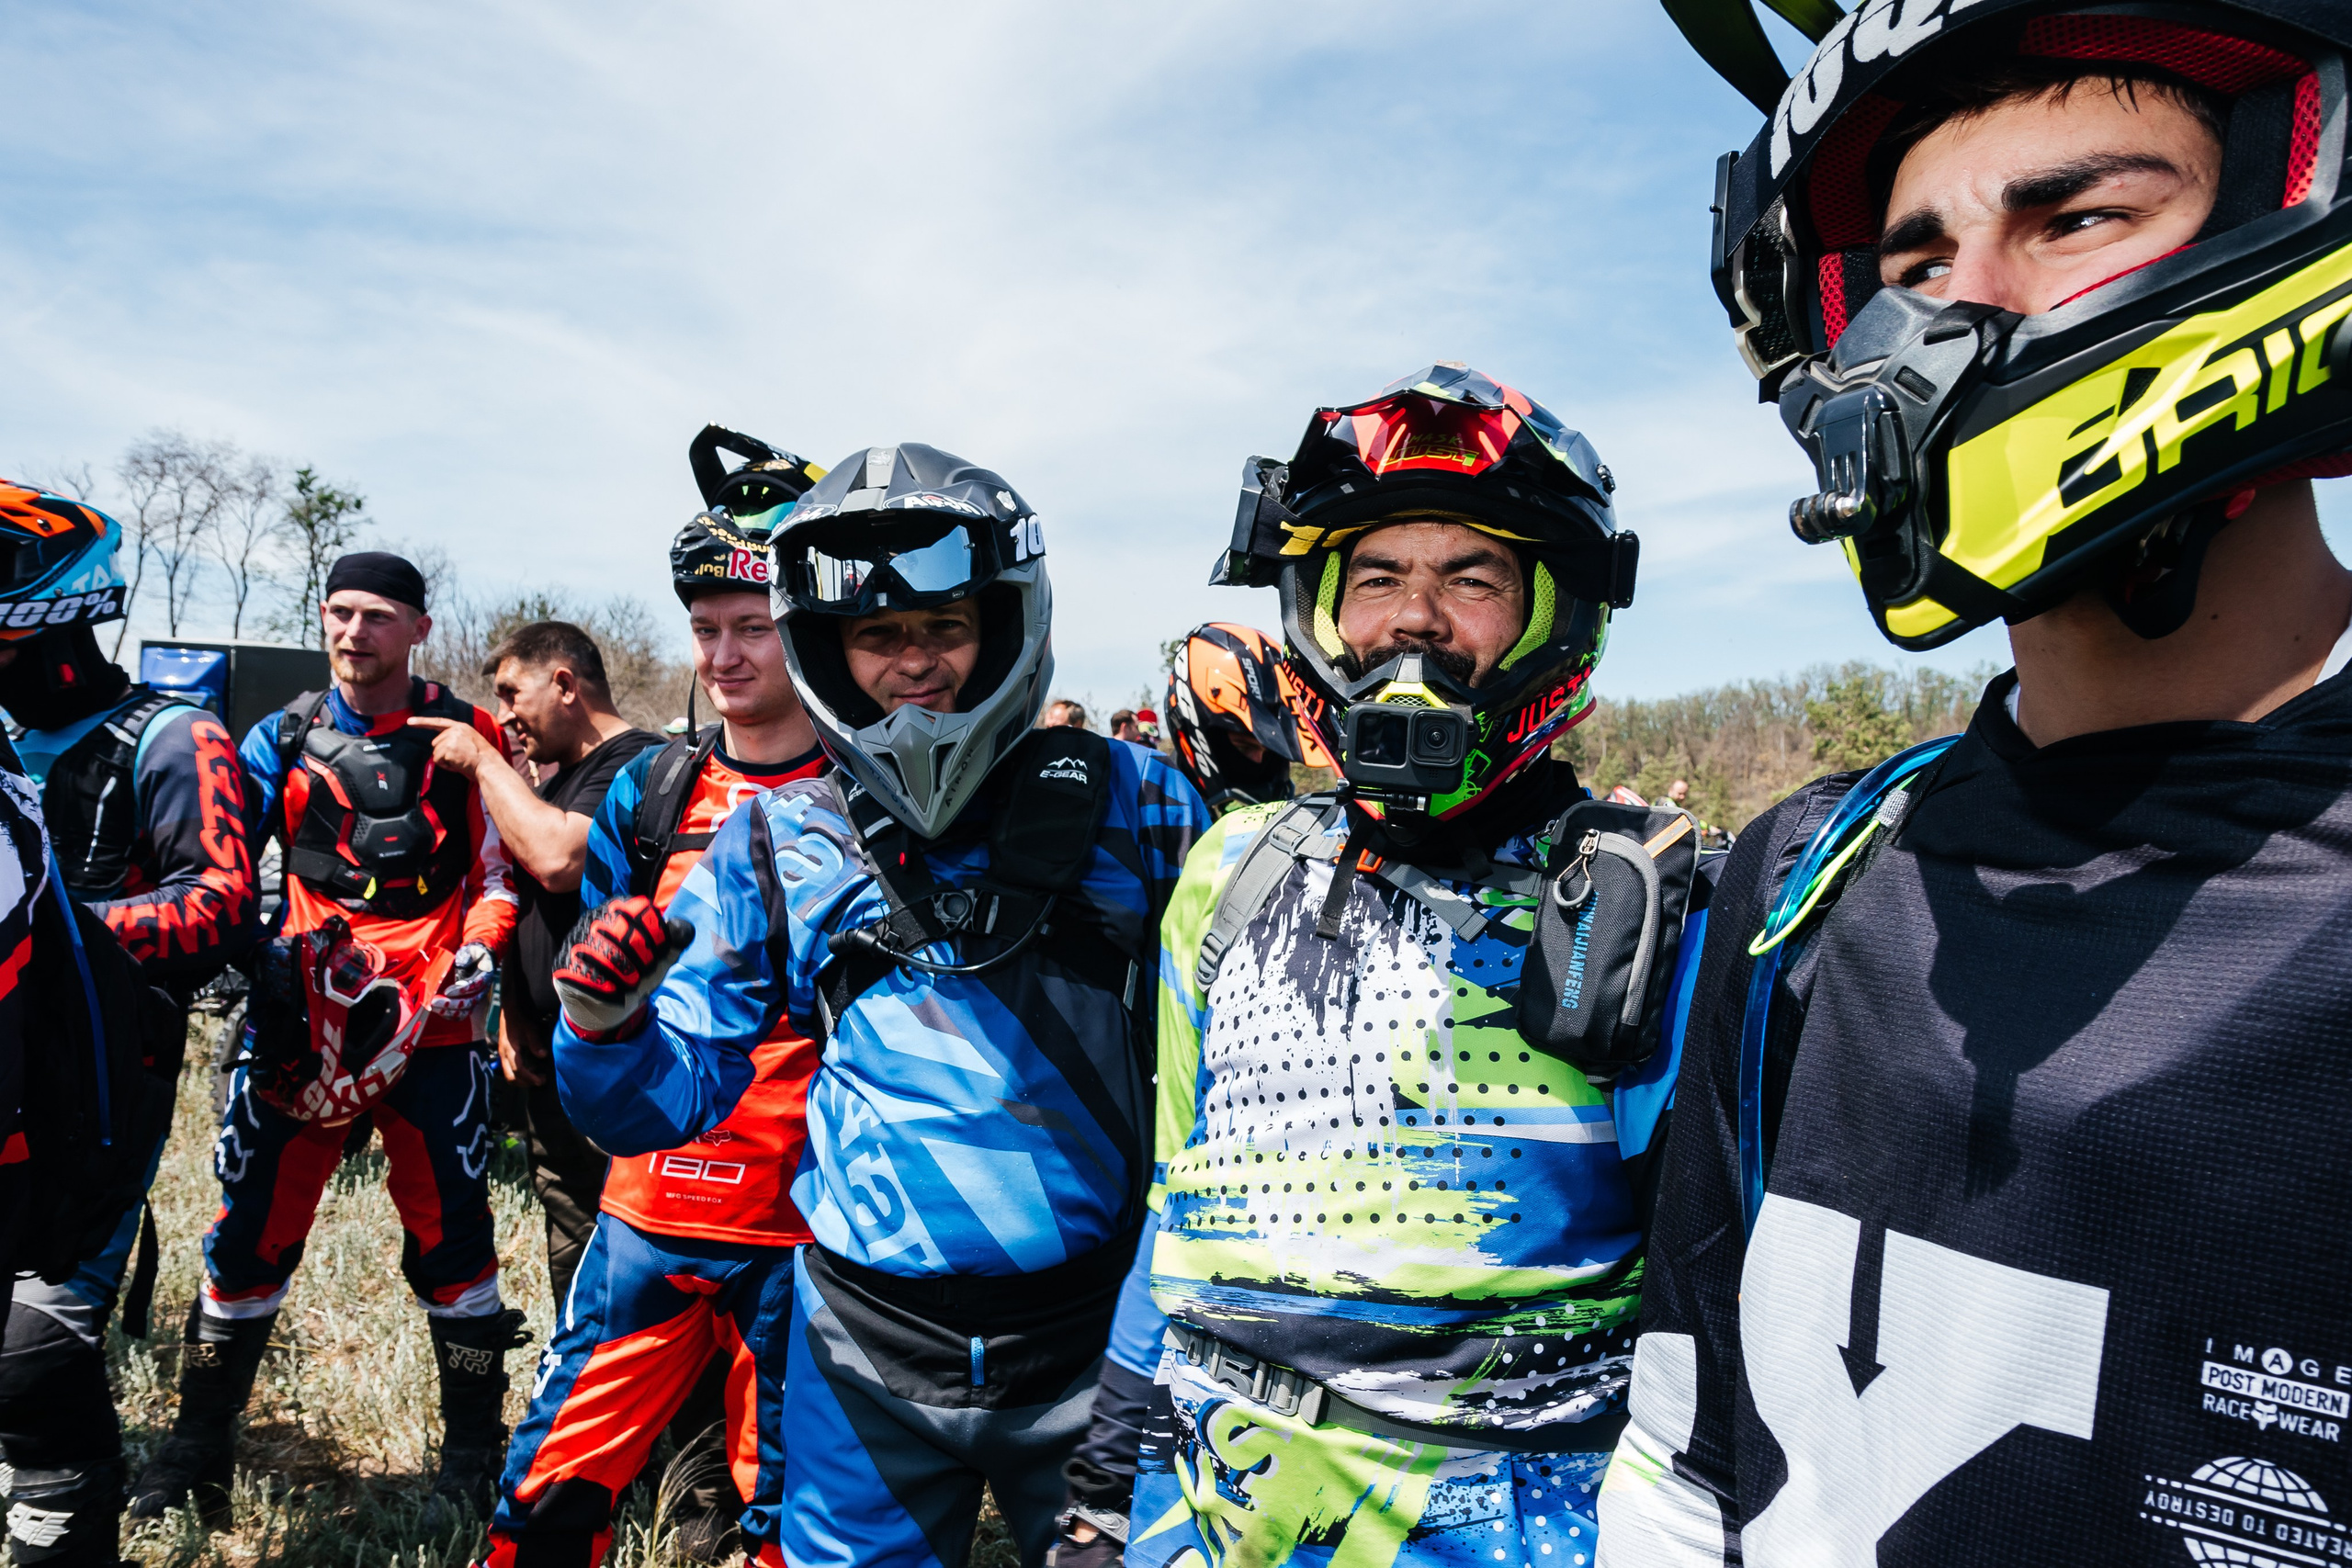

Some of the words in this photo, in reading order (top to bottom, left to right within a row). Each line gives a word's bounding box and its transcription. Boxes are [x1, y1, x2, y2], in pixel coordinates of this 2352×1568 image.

[1241, 657, 1263, 702] SPORT
[944, 747, 975, 808] AIROH
[1039, 770, 1089, 784] E-GEAR
[648, 1152, 746, 1185] 180
[683, 1194, 707, 1202] SPEED
[2208, 1366, 2256, 1393] POST
[2261, 1379, 2344, 1415] MODERN
[2202, 1393, 2251, 1421] RACE
[2278, 1411, 2340, 1443] WEAR
[2143, 1490, 2234, 1527] DESTROY
[2242, 1515, 2266, 1536] TO
